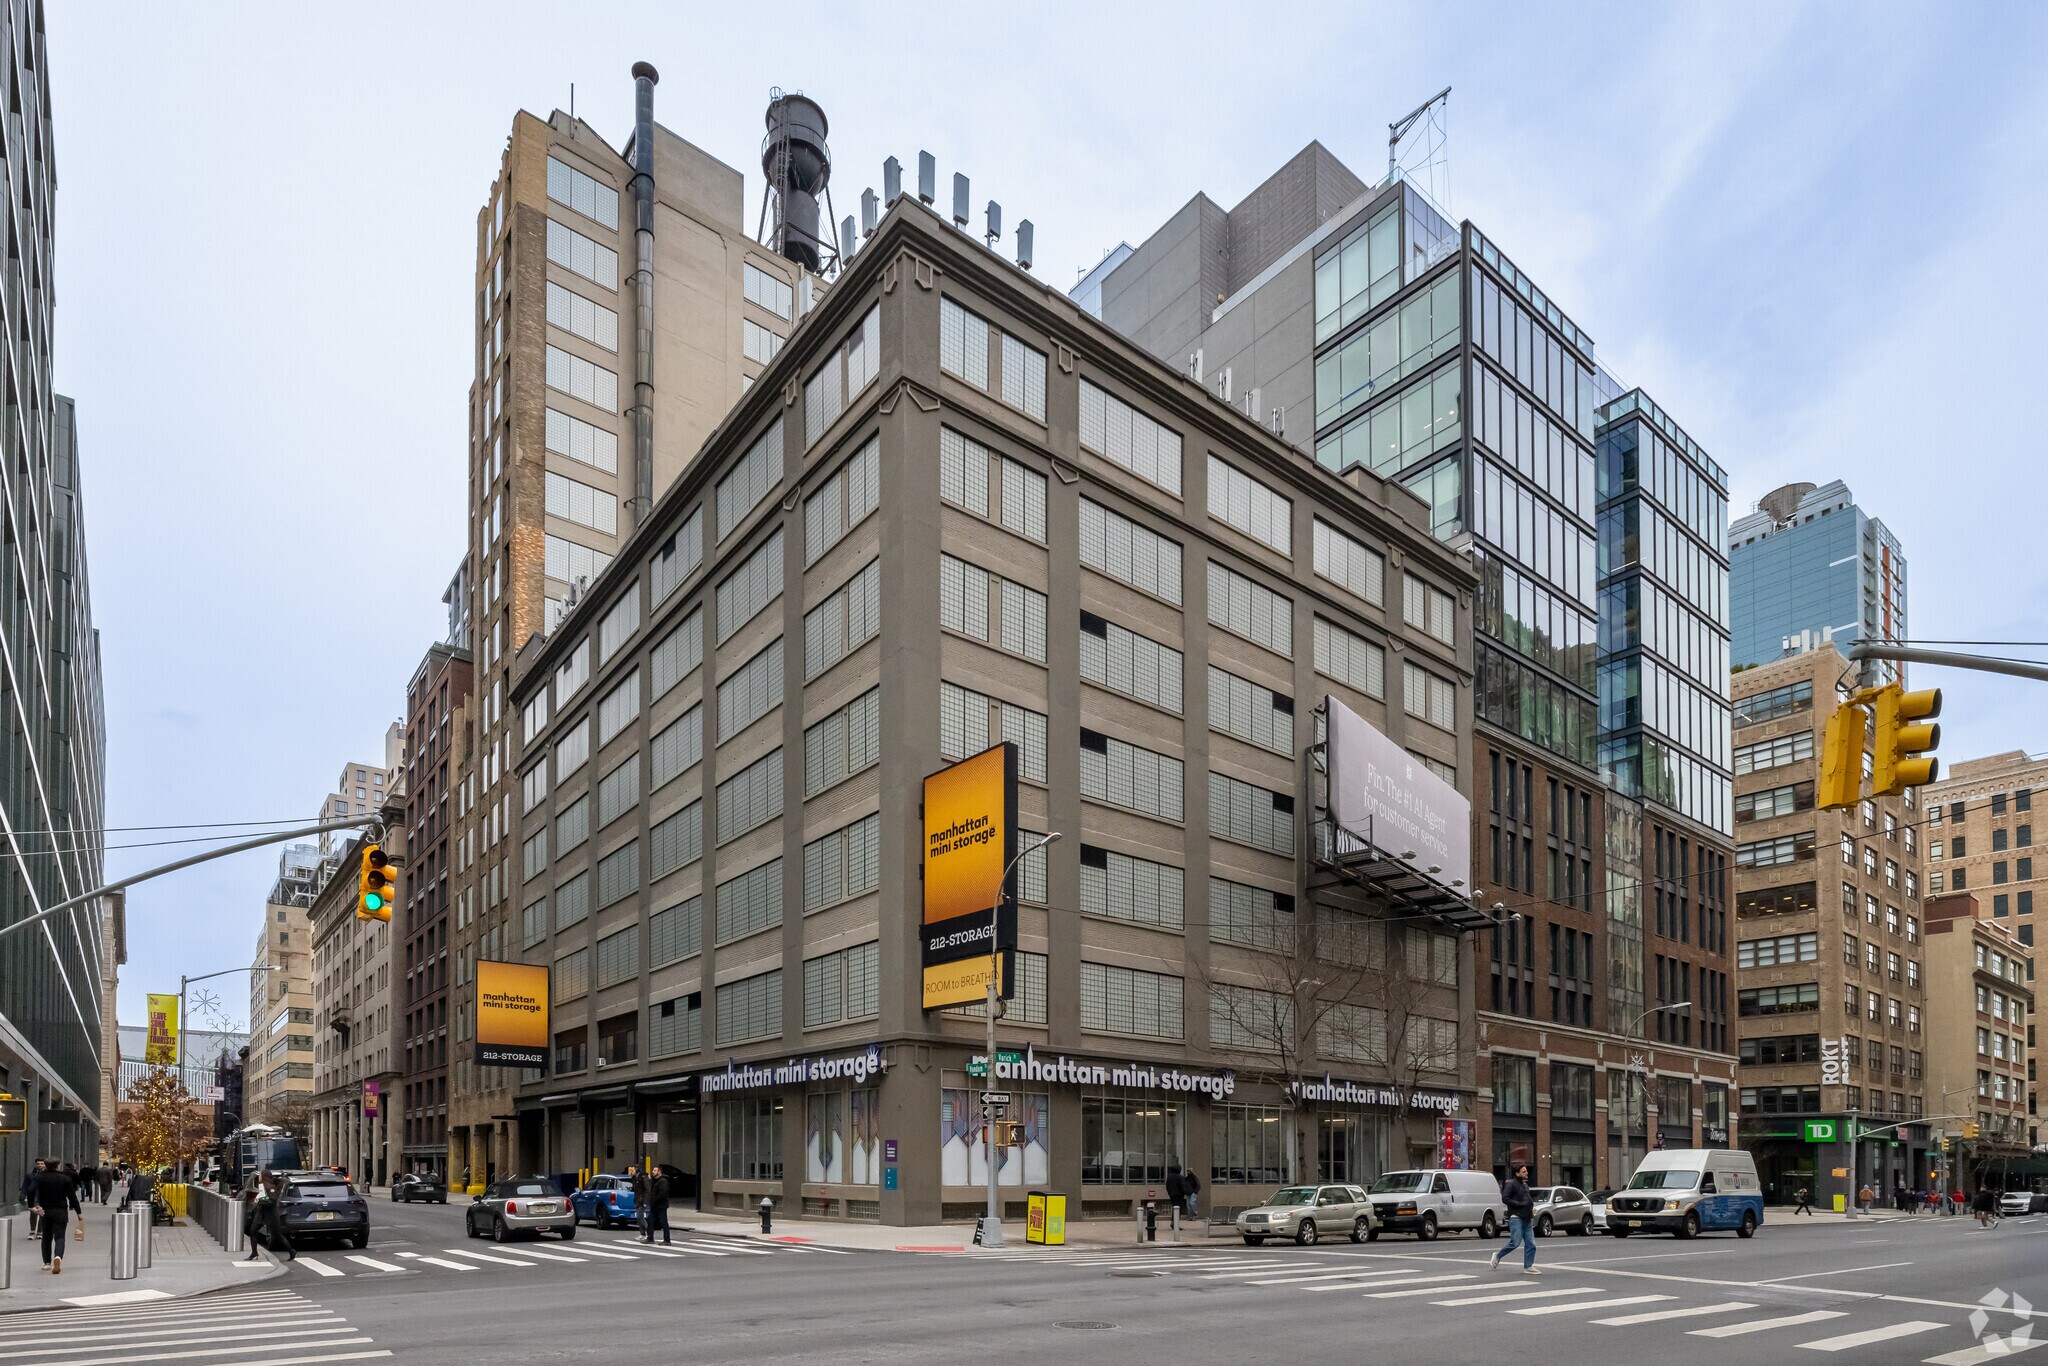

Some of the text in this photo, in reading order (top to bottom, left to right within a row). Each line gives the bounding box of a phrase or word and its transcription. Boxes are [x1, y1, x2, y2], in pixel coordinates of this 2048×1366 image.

[1367, 762, 1446, 835] Fin. The #1 AI Agent
[930, 815, 989, 845] manhattan
[1363, 787, 1449, 859] for customer service.
[930, 824, 996, 858] mini storage
[482, 992, 535, 1003] manhattan
[925, 974, 951, 994] ROOM
[952, 976, 960, 990] to
[150, 1012, 167, 1020] LEAVE
[482, 1001, 541, 1013] mini storage
[150, 1036, 176, 1045] TOURISTS
[482, 1052, 543, 1062] 212-STORAGE
[702, 1046, 879, 1093] manhattan mini storage
[1822, 1037, 1839, 1085] ROKT
[1112, 1063, 1155, 1088] mini
[1161, 1070, 1235, 1100] storage
[1292, 1072, 1460, 1116] manhattan min storage
[1808, 1124, 1833, 1138] TD
